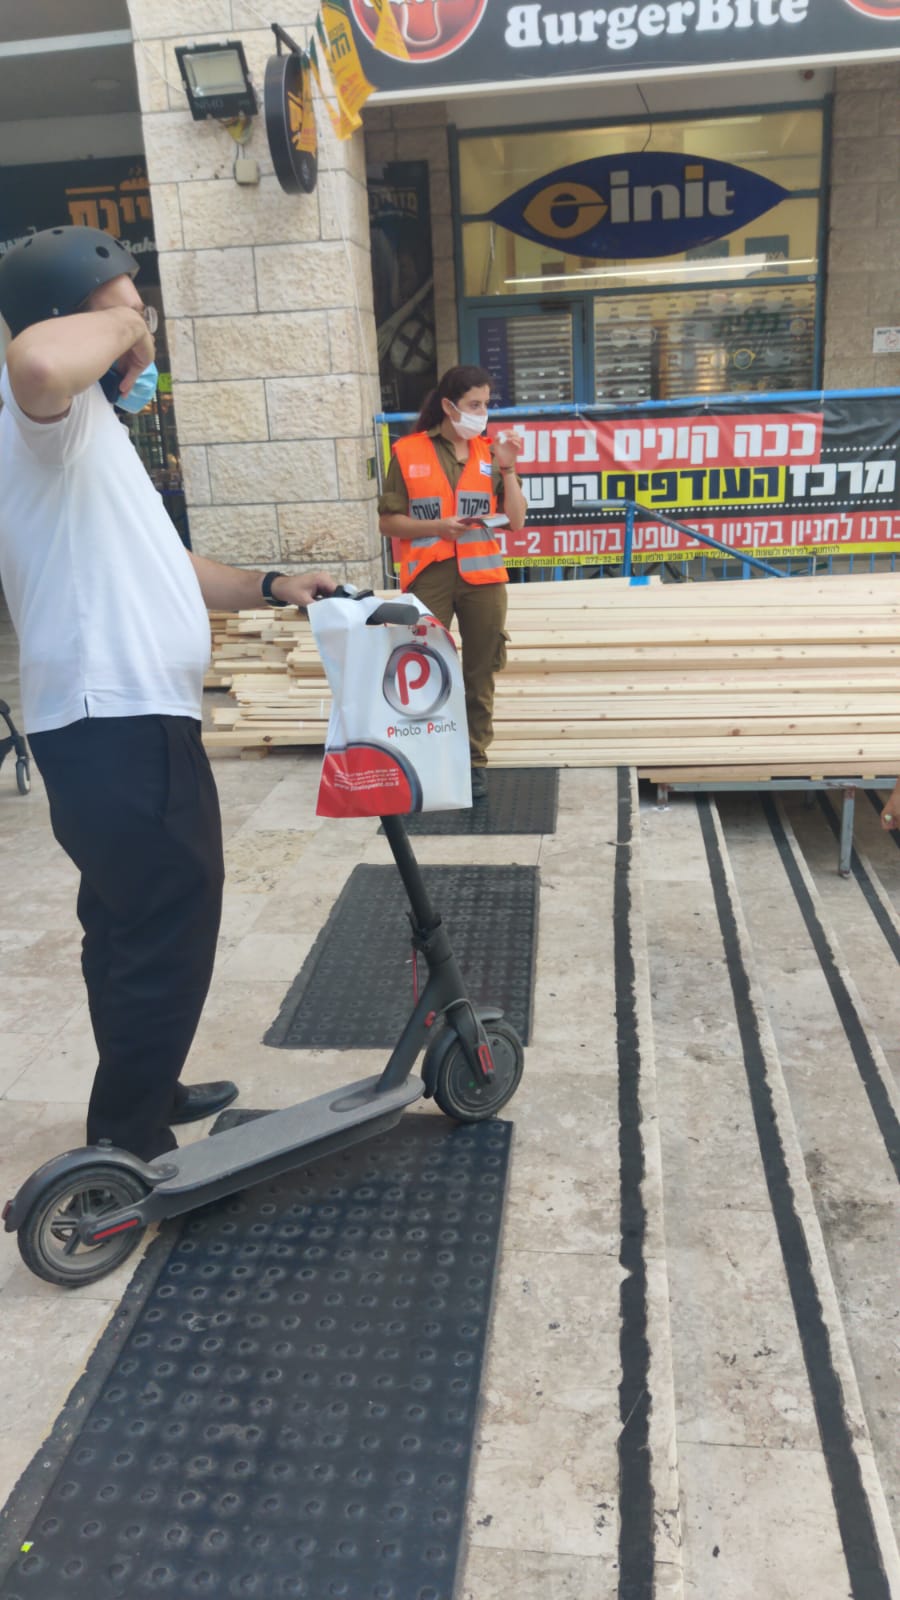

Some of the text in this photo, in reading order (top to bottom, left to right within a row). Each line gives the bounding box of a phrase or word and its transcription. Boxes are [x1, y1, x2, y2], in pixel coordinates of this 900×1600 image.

[512, 422, 817, 465] ככה קונים בזול
[521, 460, 896, 510] מרכז העודפים היש
[460, 498, 491, 518] פיקוד
[553, 528, 621, 554] בקומה
[721, 520, 784, 548] בקניון
[791, 512, 853, 546] לחניון
[387, 721, 456, 737] Photo Point
